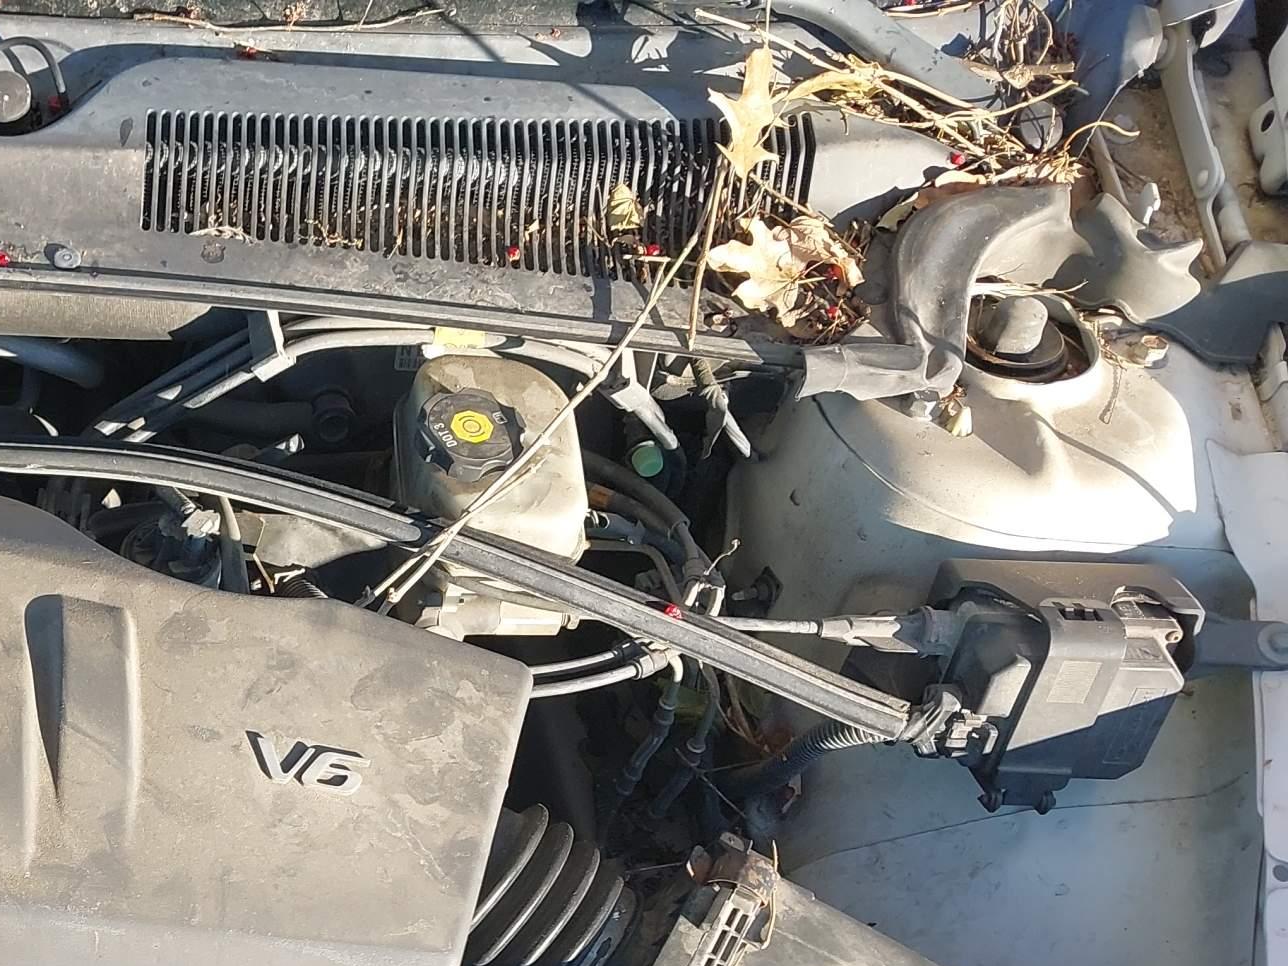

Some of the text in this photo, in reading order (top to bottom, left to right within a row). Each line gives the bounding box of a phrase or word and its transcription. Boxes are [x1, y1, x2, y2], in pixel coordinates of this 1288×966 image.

[433, 422, 458, 448] DOT 3
[245, 729, 372, 796] V6
